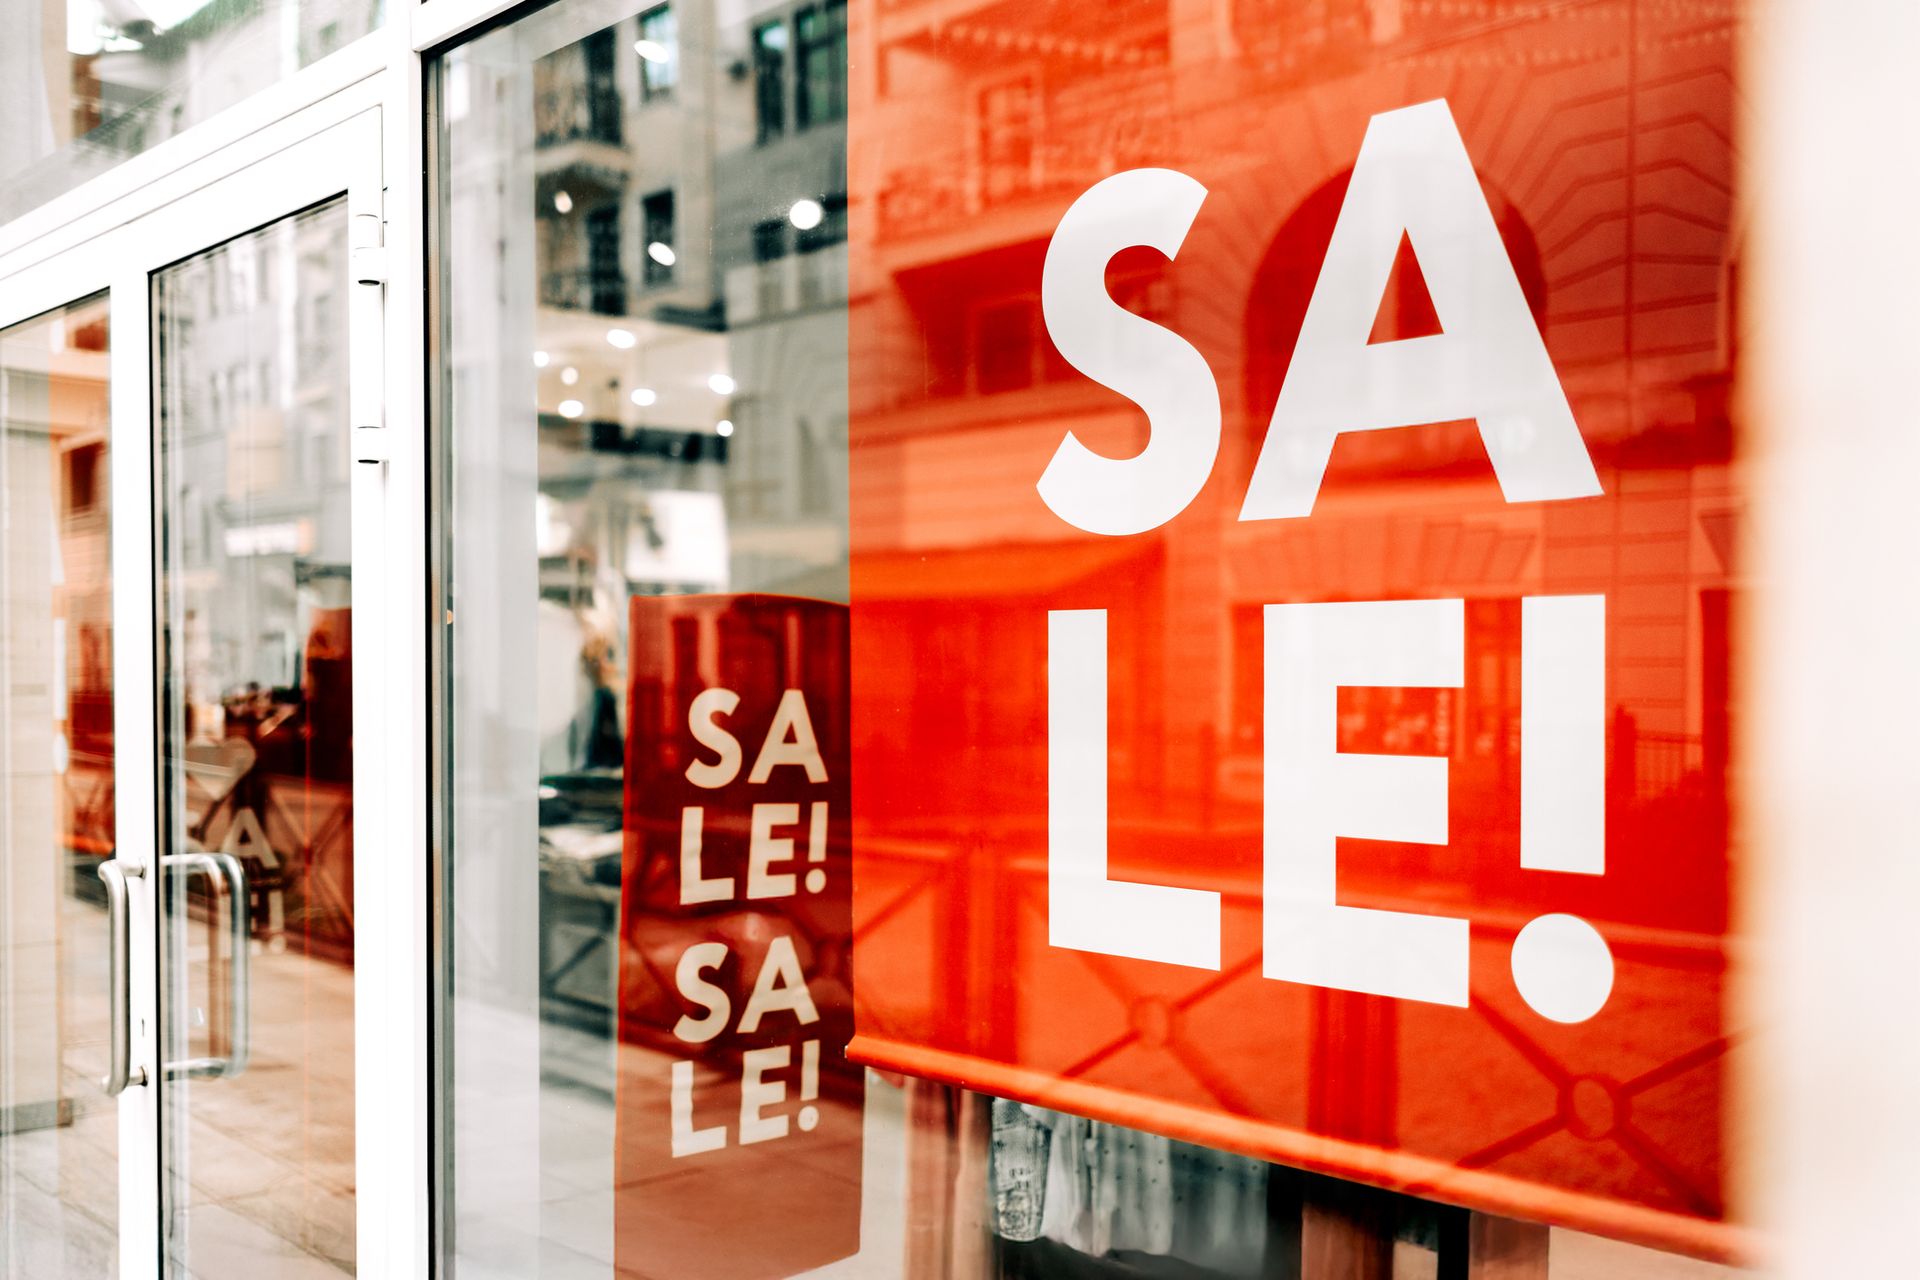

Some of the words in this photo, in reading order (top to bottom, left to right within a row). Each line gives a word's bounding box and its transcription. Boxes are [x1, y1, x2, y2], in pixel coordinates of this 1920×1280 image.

[1037, 98, 1604, 537] SA
[684, 687, 829, 789] SA
[680, 801, 829, 905] LE!
[1048, 594, 1615, 1025] LE!
[673, 935, 820, 1043] SA
[670, 1039, 820, 1159] LE!
